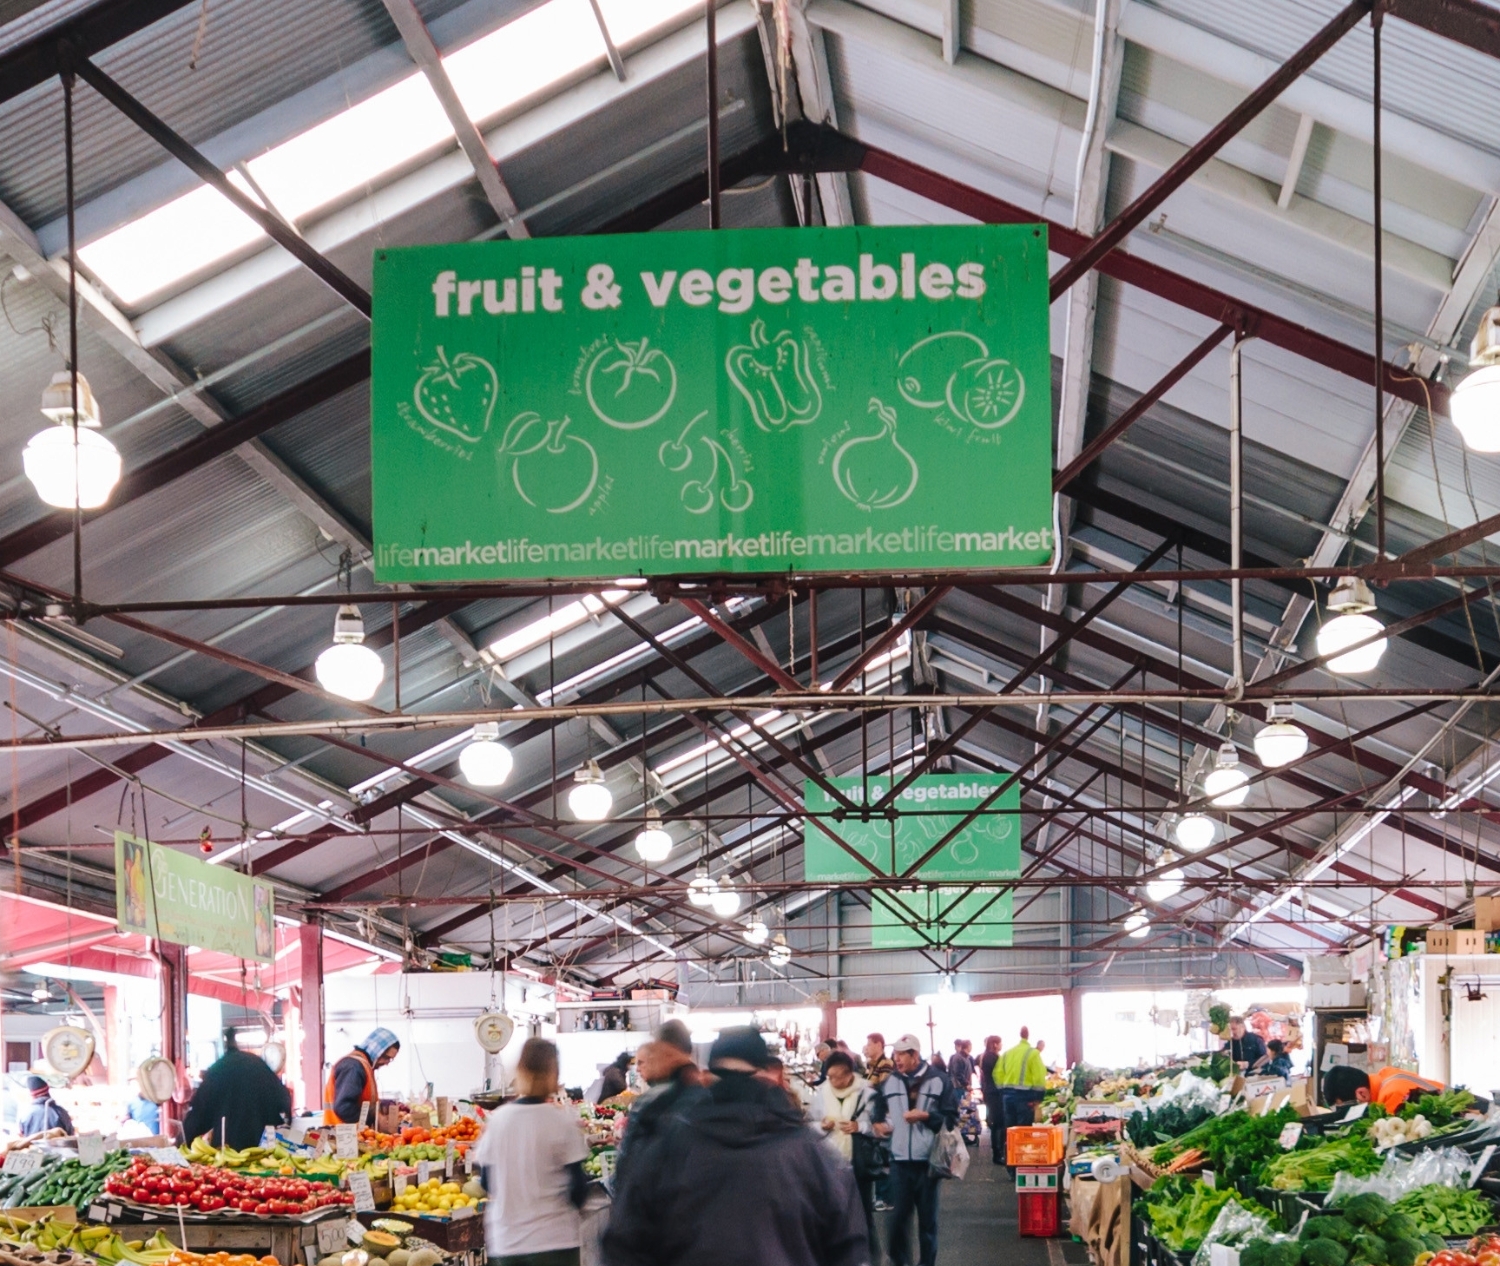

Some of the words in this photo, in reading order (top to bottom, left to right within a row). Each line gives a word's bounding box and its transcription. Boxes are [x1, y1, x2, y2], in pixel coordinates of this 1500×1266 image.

[432, 267, 564, 317] fruit
[579, 263, 623, 309] &
[640, 252, 987, 314] vegetables
